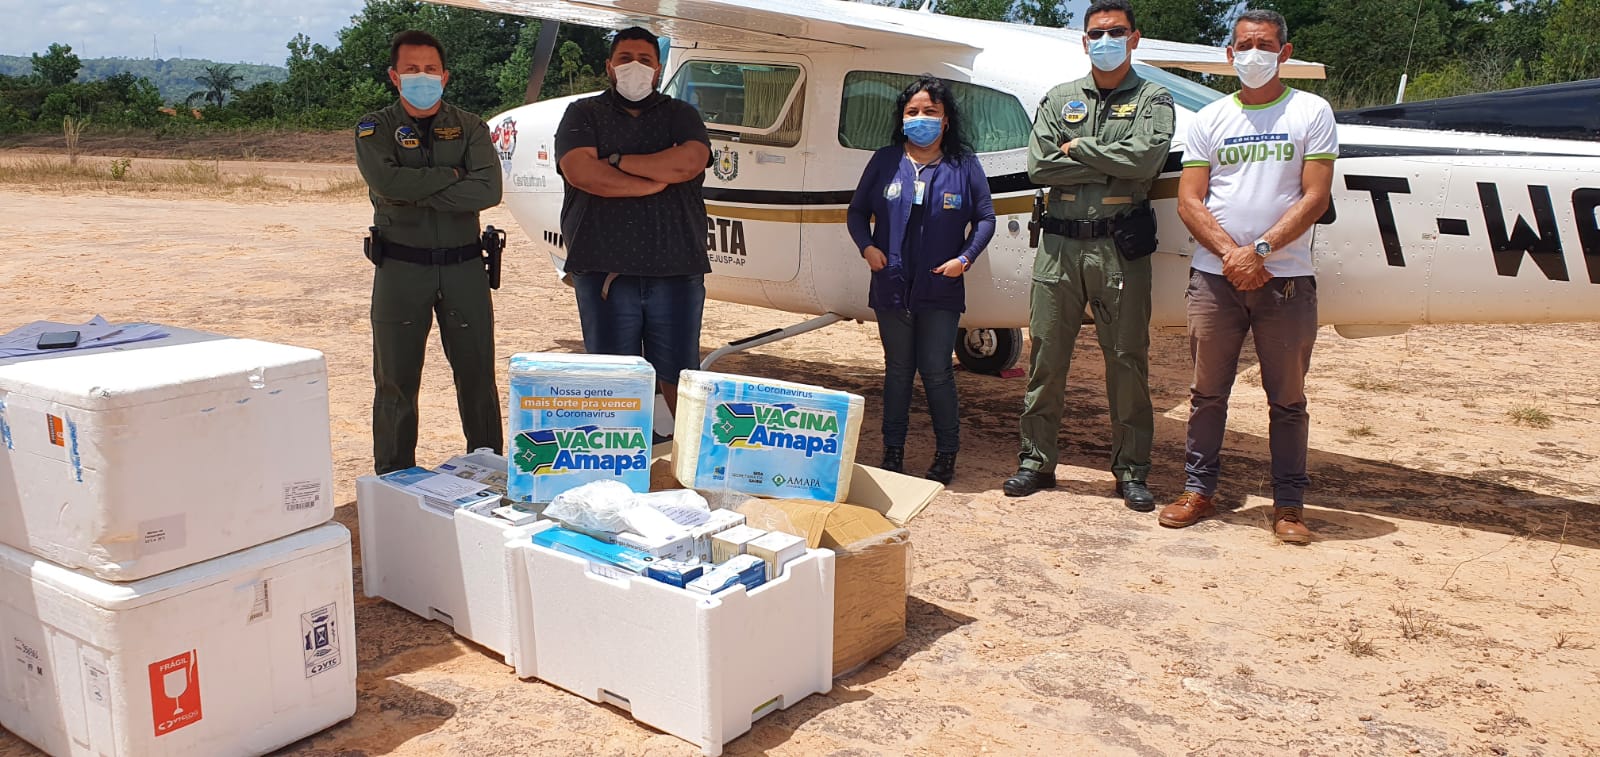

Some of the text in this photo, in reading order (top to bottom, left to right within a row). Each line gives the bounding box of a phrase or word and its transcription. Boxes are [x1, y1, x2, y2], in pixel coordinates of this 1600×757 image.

[1217, 142, 1295, 166] COVID-19
[708, 253, 746, 266] EJUSP-AP
[550, 386, 613, 398] Nossa gente
[524, 398, 638, 409] mais forte pra vencer
[754, 406, 839, 433] VACINA
[555, 431, 647, 449] VACINA
[747, 425, 838, 458] Amapá
[552, 450, 647, 476] Amapá
